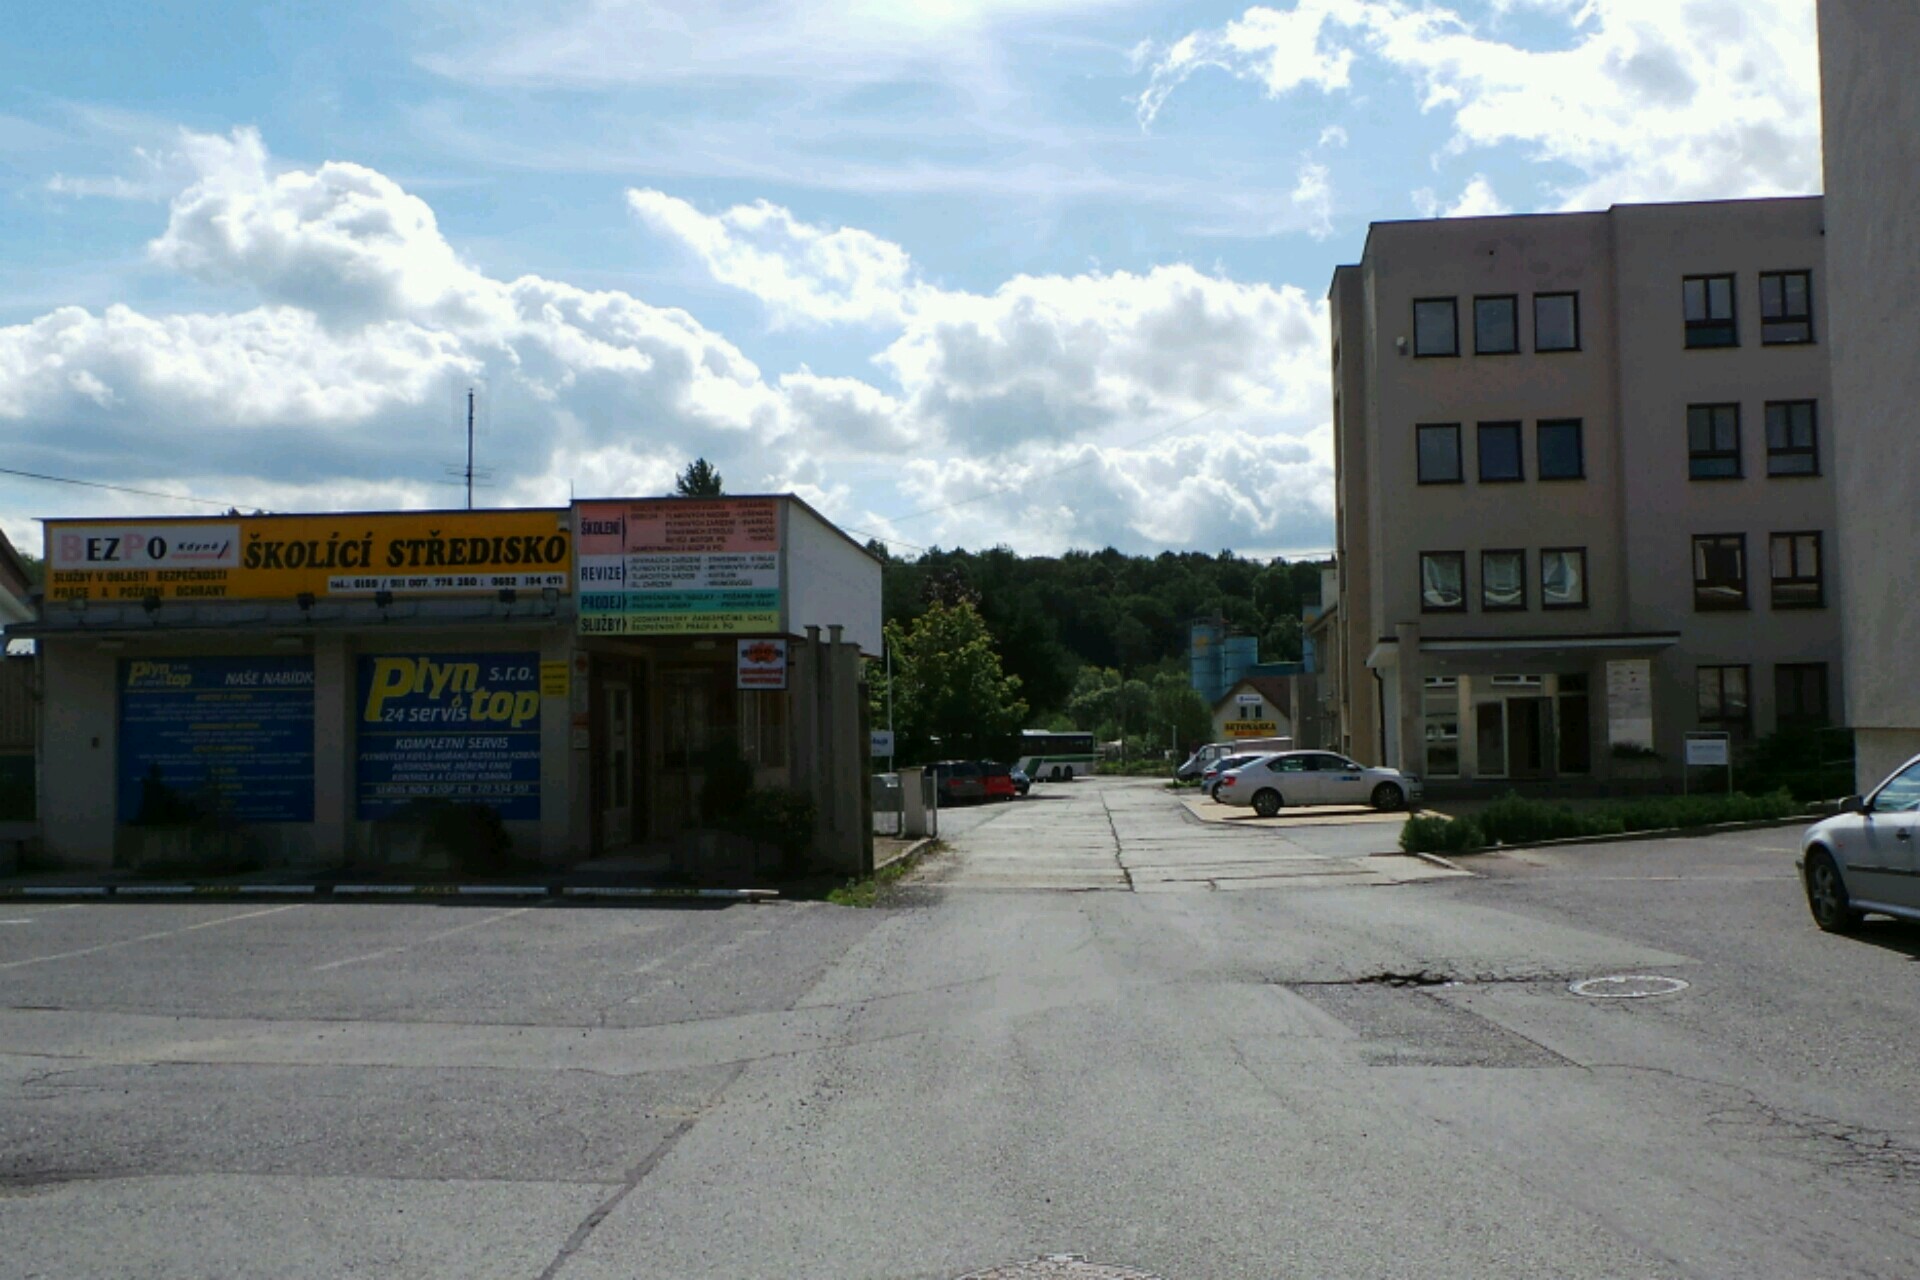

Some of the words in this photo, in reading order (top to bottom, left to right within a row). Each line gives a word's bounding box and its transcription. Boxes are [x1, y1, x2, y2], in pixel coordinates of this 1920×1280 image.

[581, 517, 621, 535] ŠKOLENÍ
[244, 531, 373, 570] ŠKOLÍCÍ
[387, 529, 566, 567] STŘEDISKO
[581, 565, 622, 582] REVIZE
[176, 584, 227, 597] OCHRANY
[581, 592, 621, 611] PRODEJ
[581, 613, 622, 633] SLUŽBY
[225, 669, 259, 686] NAŠE
[488, 666, 535, 681] s.r.o.
[364, 657, 478, 722] Plyn
[385, 707, 406, 722] 24
[408, 700, 468, 722] servis
[469, 687, 541, 728] top
[395, 736, 465, 750] KOMPLETNÍ
[468, 737, 509, 749] SERVIS
